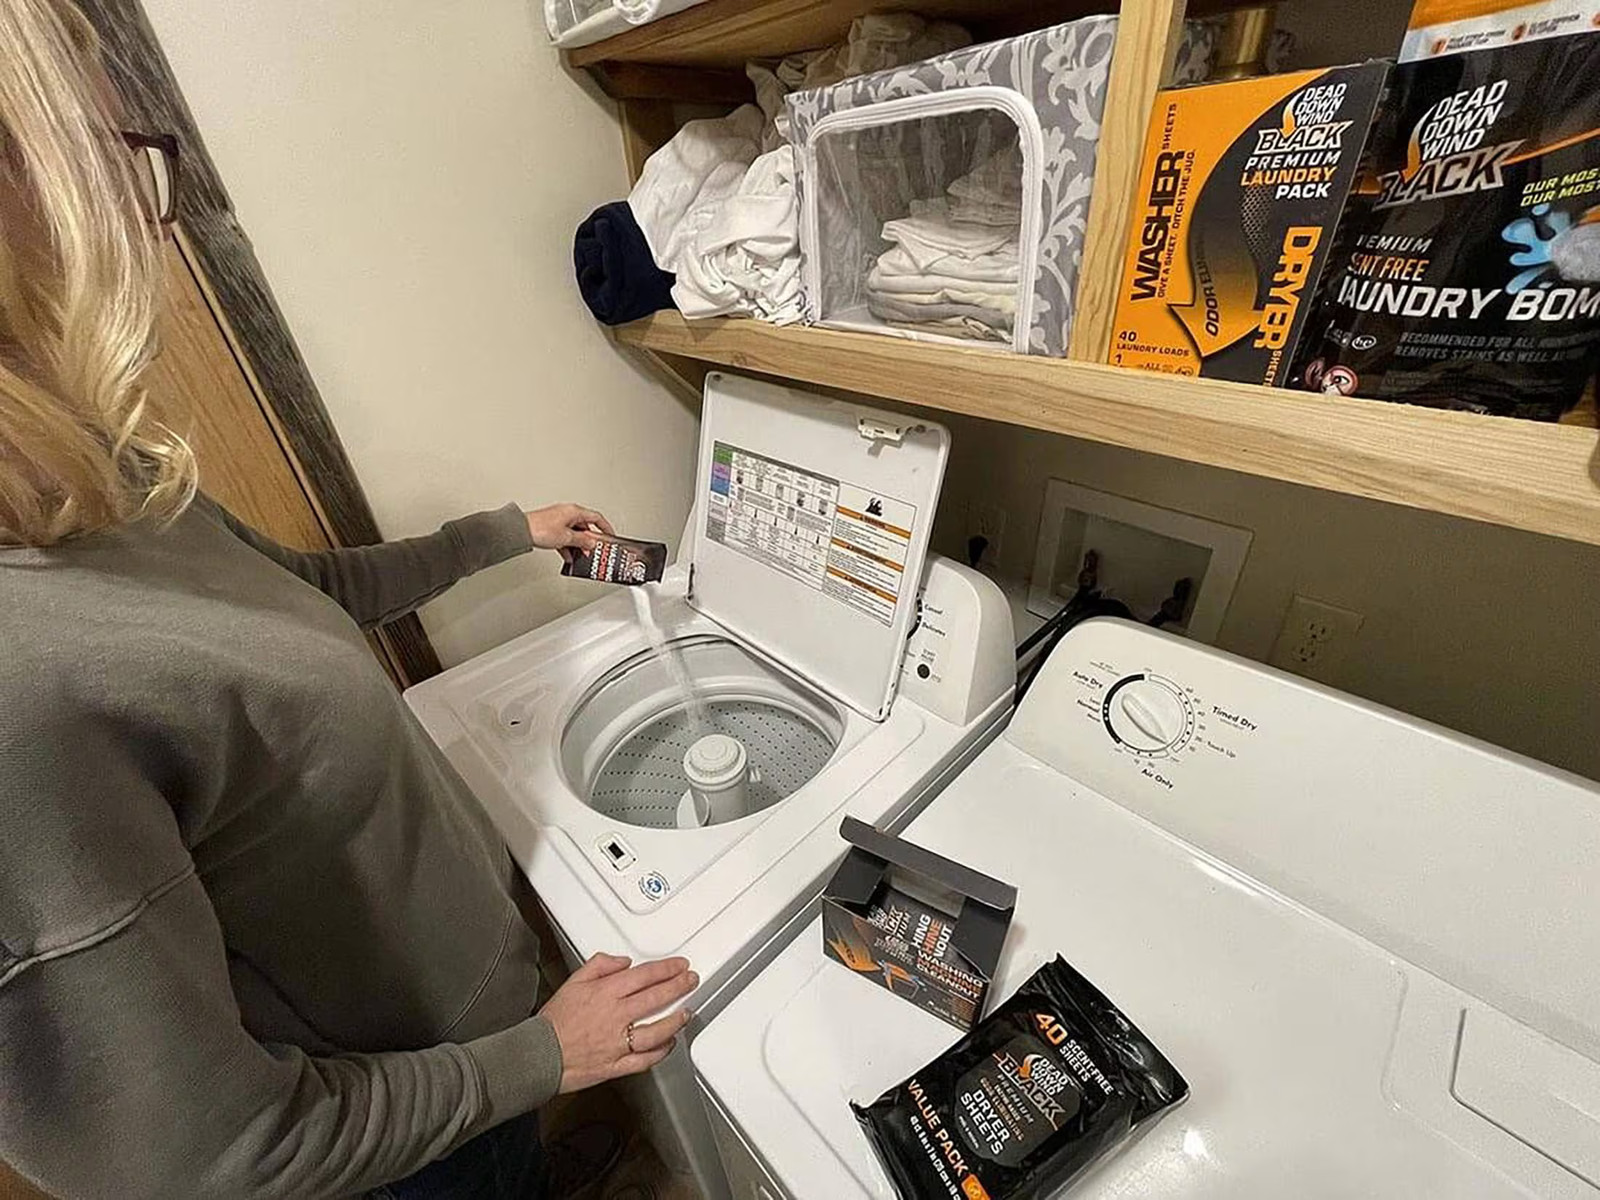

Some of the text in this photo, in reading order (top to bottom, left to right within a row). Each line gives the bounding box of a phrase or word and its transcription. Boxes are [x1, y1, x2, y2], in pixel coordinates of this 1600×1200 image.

[1295, 96, 1344, 115] DOWN
[1303, 83, 1347, 101] DEAD
[1433, 79, 1508, 121] DEAD
[1162, 103, 1177, 149] SHEETS
[1297, 111, 1334, 126] WIND
[1421, 101, 1504, 144] DOWN
[1253, 120, 1354, 154] BLACK
[1422, 128, 1485, 161] WIND
[1245, 151, 1341, 170] PREMIUM
[1178, 176, 1190, 200] THE
[1241, 166, 1337, 186] LAUNDRY
[1522, 168, 1600, 194] OUR MOS
[1275, 183, 1331, 199] PACK
[1520, 191, 1555, 207] OUR
[1131, 150, 1185, 301] WASHER
[1173, 202, 1184, 229] DITCH
[1356, 234, 1432, 253] EMIUM
[1164, 267, 1171, 275] A
[1380, 258, 1430, 281] FREE
[1157, 275, 1168, 298] GIVE
[1254, 226, 1323, 349] DRYER
[1203, 287, 1219, 337] ODOR
[1117, 343, 1189, 356] LAUNDRY LOADS
[1119, 331, 1137, 342] 40
[1400, 332, 1486, 348] RECOMMENDED
[1486, 336, 1513, 348] FOR
[1512, 336, 1535, 348] ALL
[1115, 354, 1122, 364] 1
[1394, 345, 1449, 360] REMOVES
[1451, 348, 1494, 362] STAINS
[1517, 351, 1548, 363] WELL
[1263, 351, 1283, 388] SHEET
[1073, 671, 1089, 681] Auto
[1090, 678, 1103, 688] Dry
[1212, 706, 1240, 722] Timed
[1240, 718, 1258, 731] Dry
[1141, 768, 1174, 789] Air Only
[916, 963, 980, 999] CLEANOUT
[917, 949, 983, 988] WASHING
[1036, 1013, 1068, 1046] 40
[1040, 1058, 1068, 1085] DEAD
[1059, 1045, 1091, 1082] SHEETS
[1067, 1039, 1114, 1095] SCENT-FREE
[997, 1053, 1066, 1122] BLACK
[1031, 1068, 1056, 1096] WIND
[1032, 1061, 1064, 1094] DOWN
[997, 1074, 1034, 1123] PREMIUM
[908, 1079, 941, 1130] VALUE
[935, 1128, 969, 1177] PACK
[960, 1092, 1004, 1155] SHEETS
[973, 1089, 1010, 1142] DRYER
